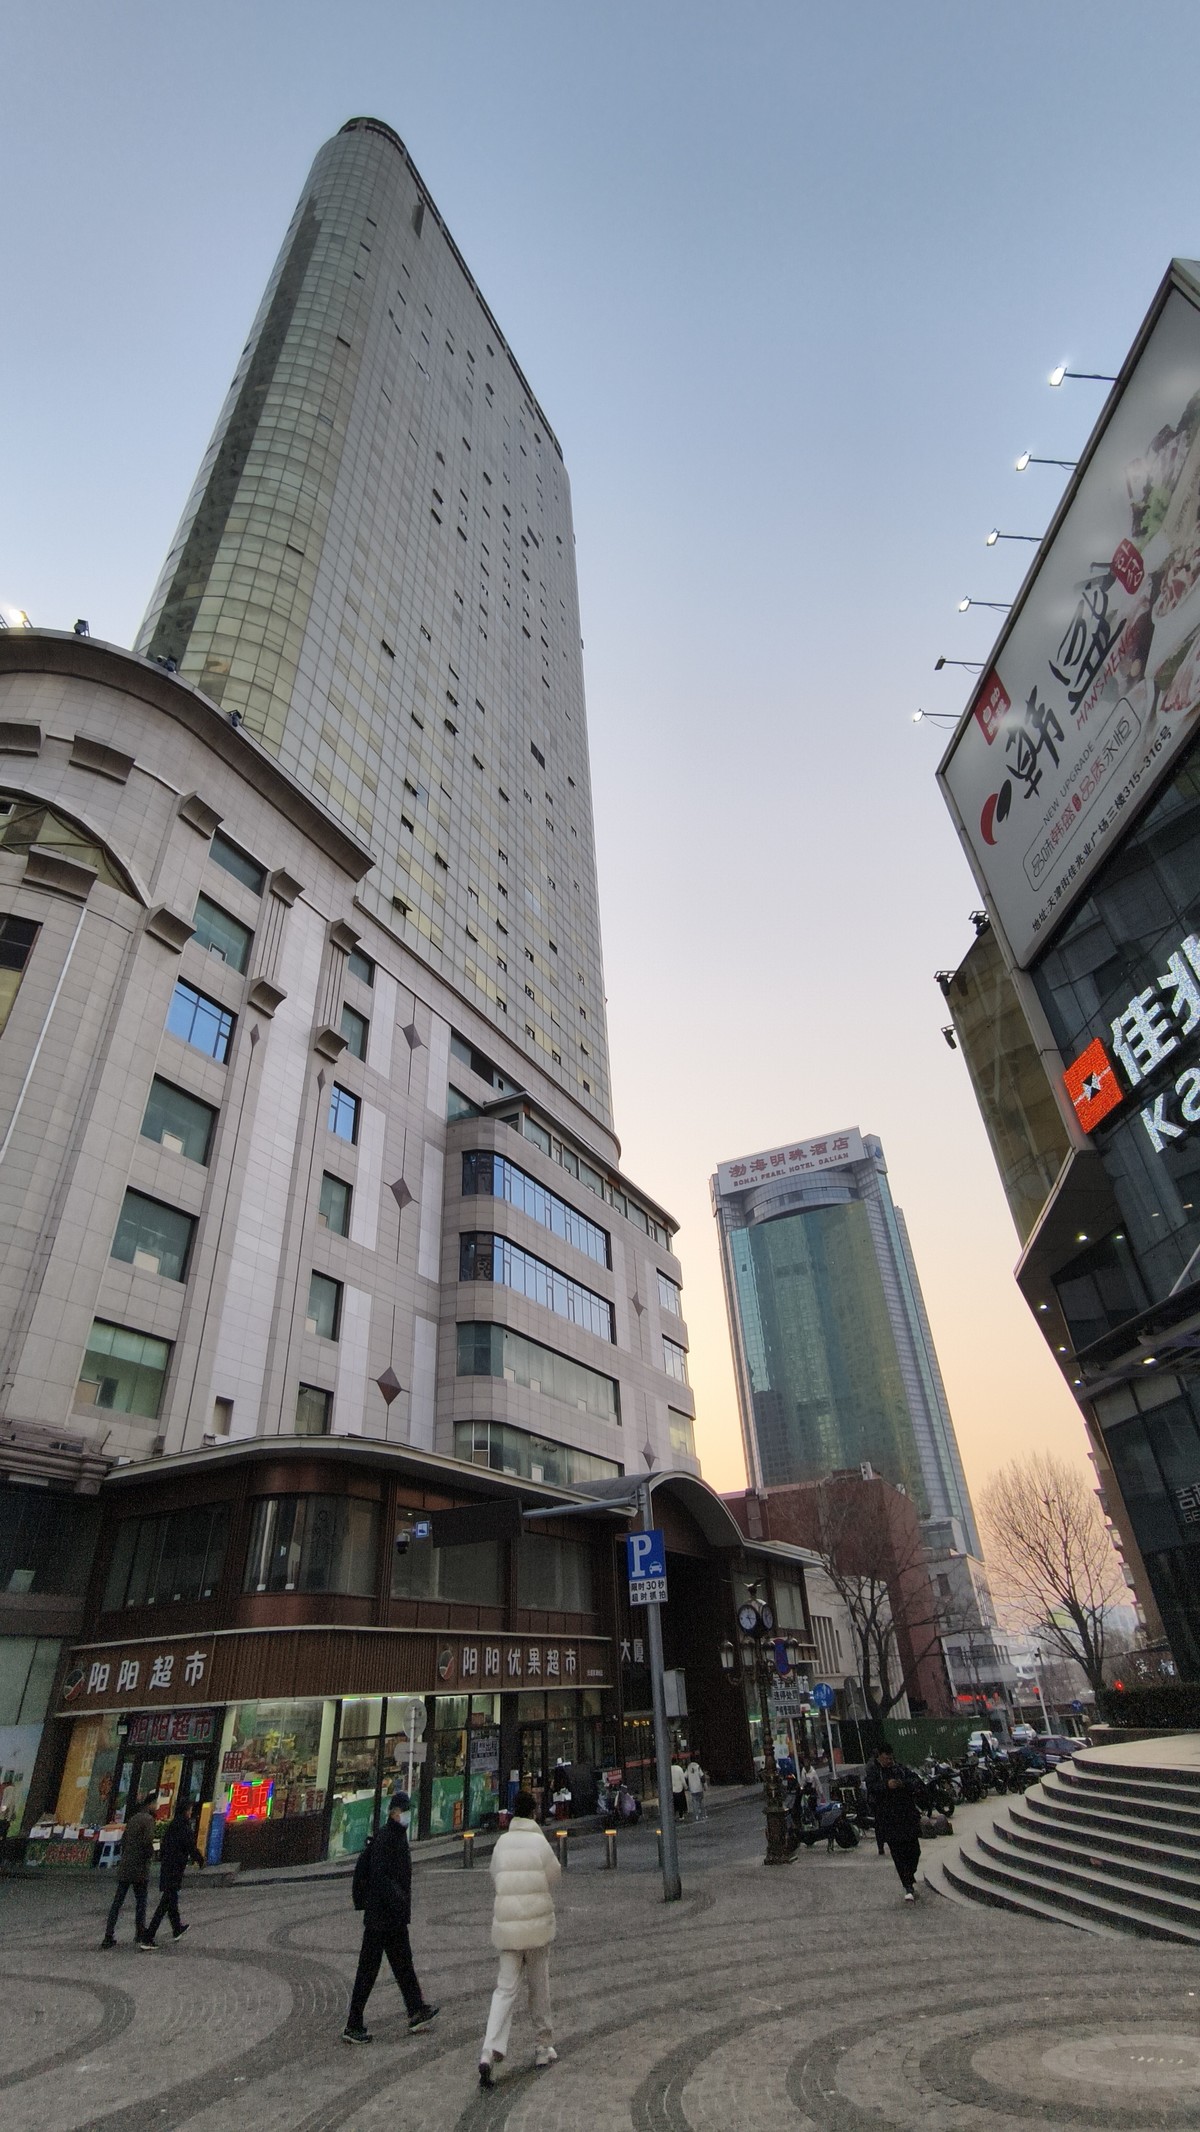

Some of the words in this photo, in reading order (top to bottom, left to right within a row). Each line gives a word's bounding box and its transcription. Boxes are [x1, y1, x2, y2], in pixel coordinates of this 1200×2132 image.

[1076, 628, 1139, 730] HANSHENG
[1031, 805, 1077, 878] 品味韩盛
[1081, 716, 1133, 803] 品质永恒
[1043, 800, 1060, 827] NEW
[1060, 742, 1095, 798] UPGRADE
[728, 1136, 850, 1178] 渤海明珠酒店
[734, 1176, 758, 1187] BOHAI
[761, 1170, 786, 1180] PEARL
[789, 1161, 815, 1173] HOTEL
[819, 1152, 849, 1165] DALIAN
[630, 1534, 652, 1578] P
[87, 1650, 208, 1695] 阳阳超市
[462, 1646, 577, 1678] 阳阳优果超市
[232, 1783, 269, 1807] 超市
